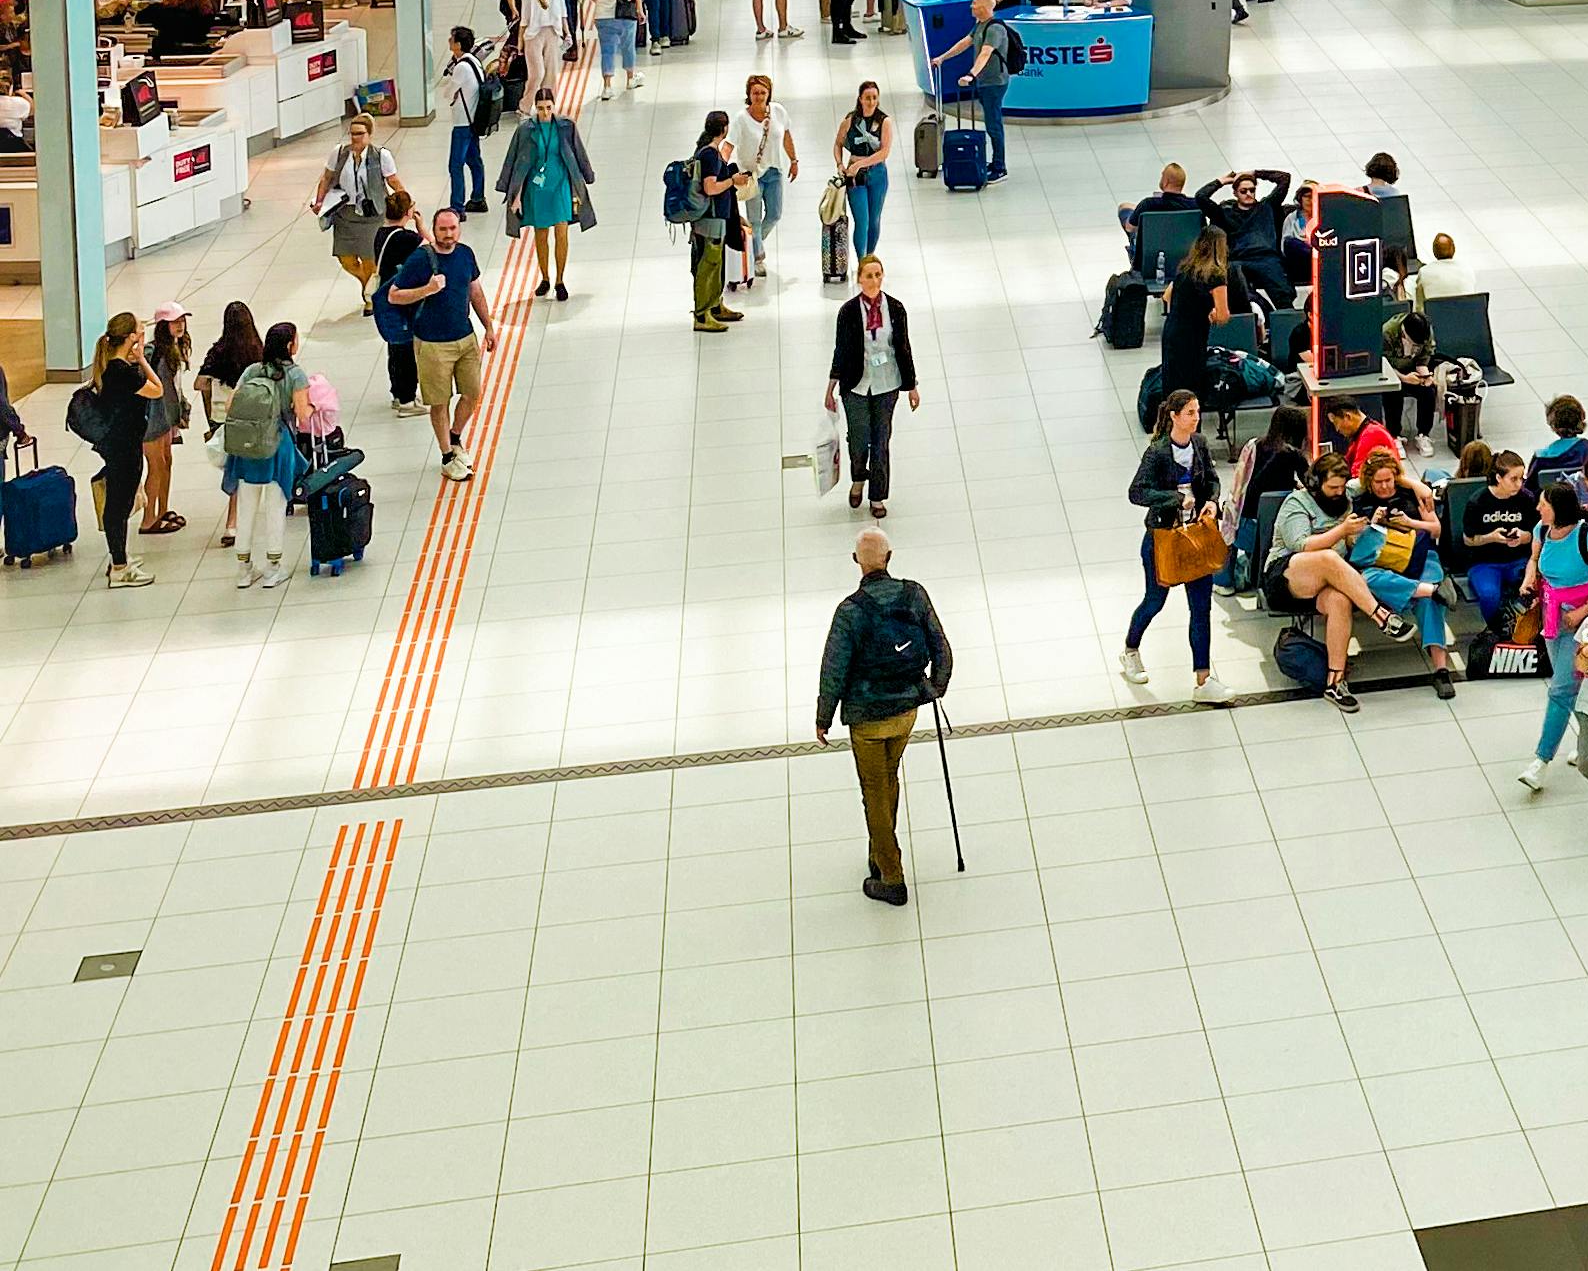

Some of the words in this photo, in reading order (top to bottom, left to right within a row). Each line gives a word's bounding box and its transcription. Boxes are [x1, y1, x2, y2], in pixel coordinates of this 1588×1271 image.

[1318, 236, 1338, 247] bud
[1482, 510, 1523, 523] adidas
[1488, 647, 1539, 675] NIKE
